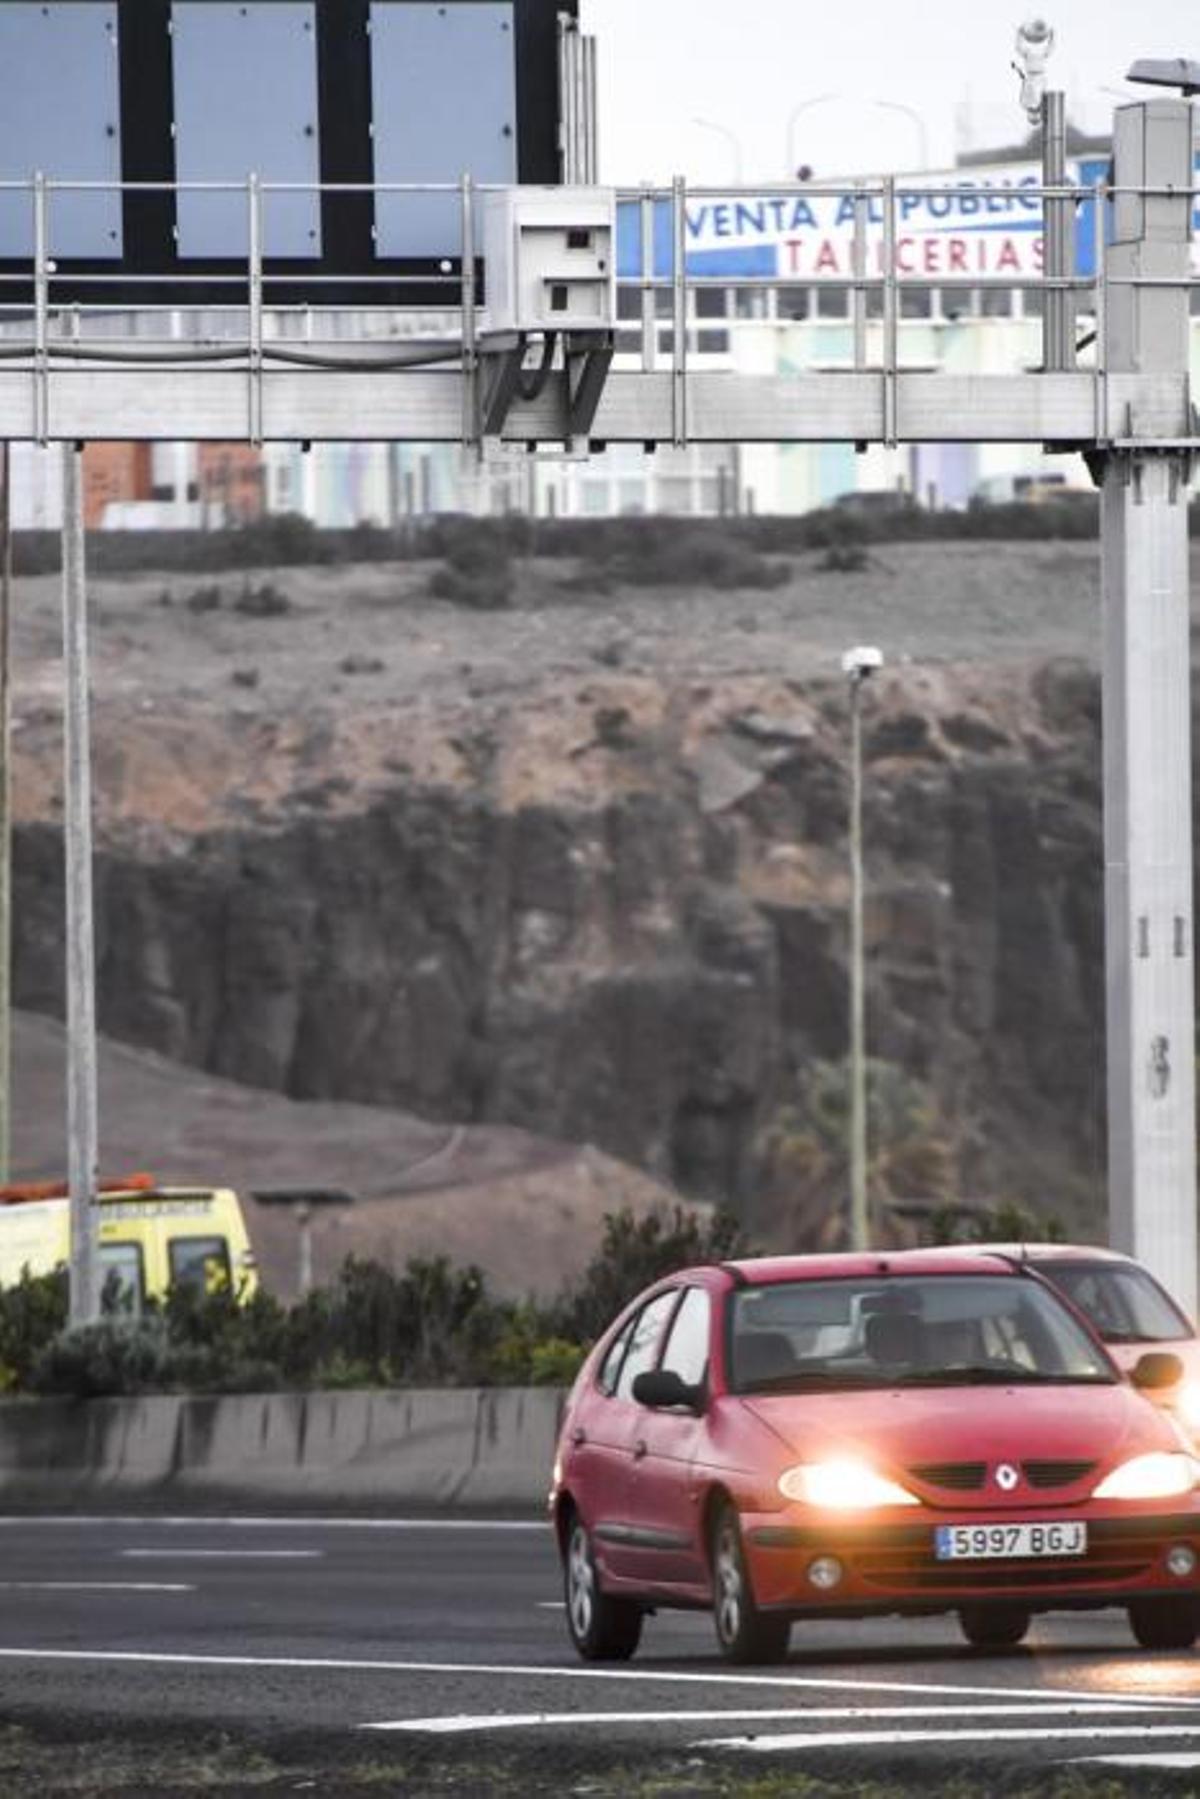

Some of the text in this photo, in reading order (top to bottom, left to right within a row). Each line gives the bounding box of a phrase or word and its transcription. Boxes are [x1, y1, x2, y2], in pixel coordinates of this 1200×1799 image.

[684, 198, 817, 238] VENTA
[901, 176, 1073, 219] PUBLIC
[955, 1526, 1080, 1554] 5997 BGJ
